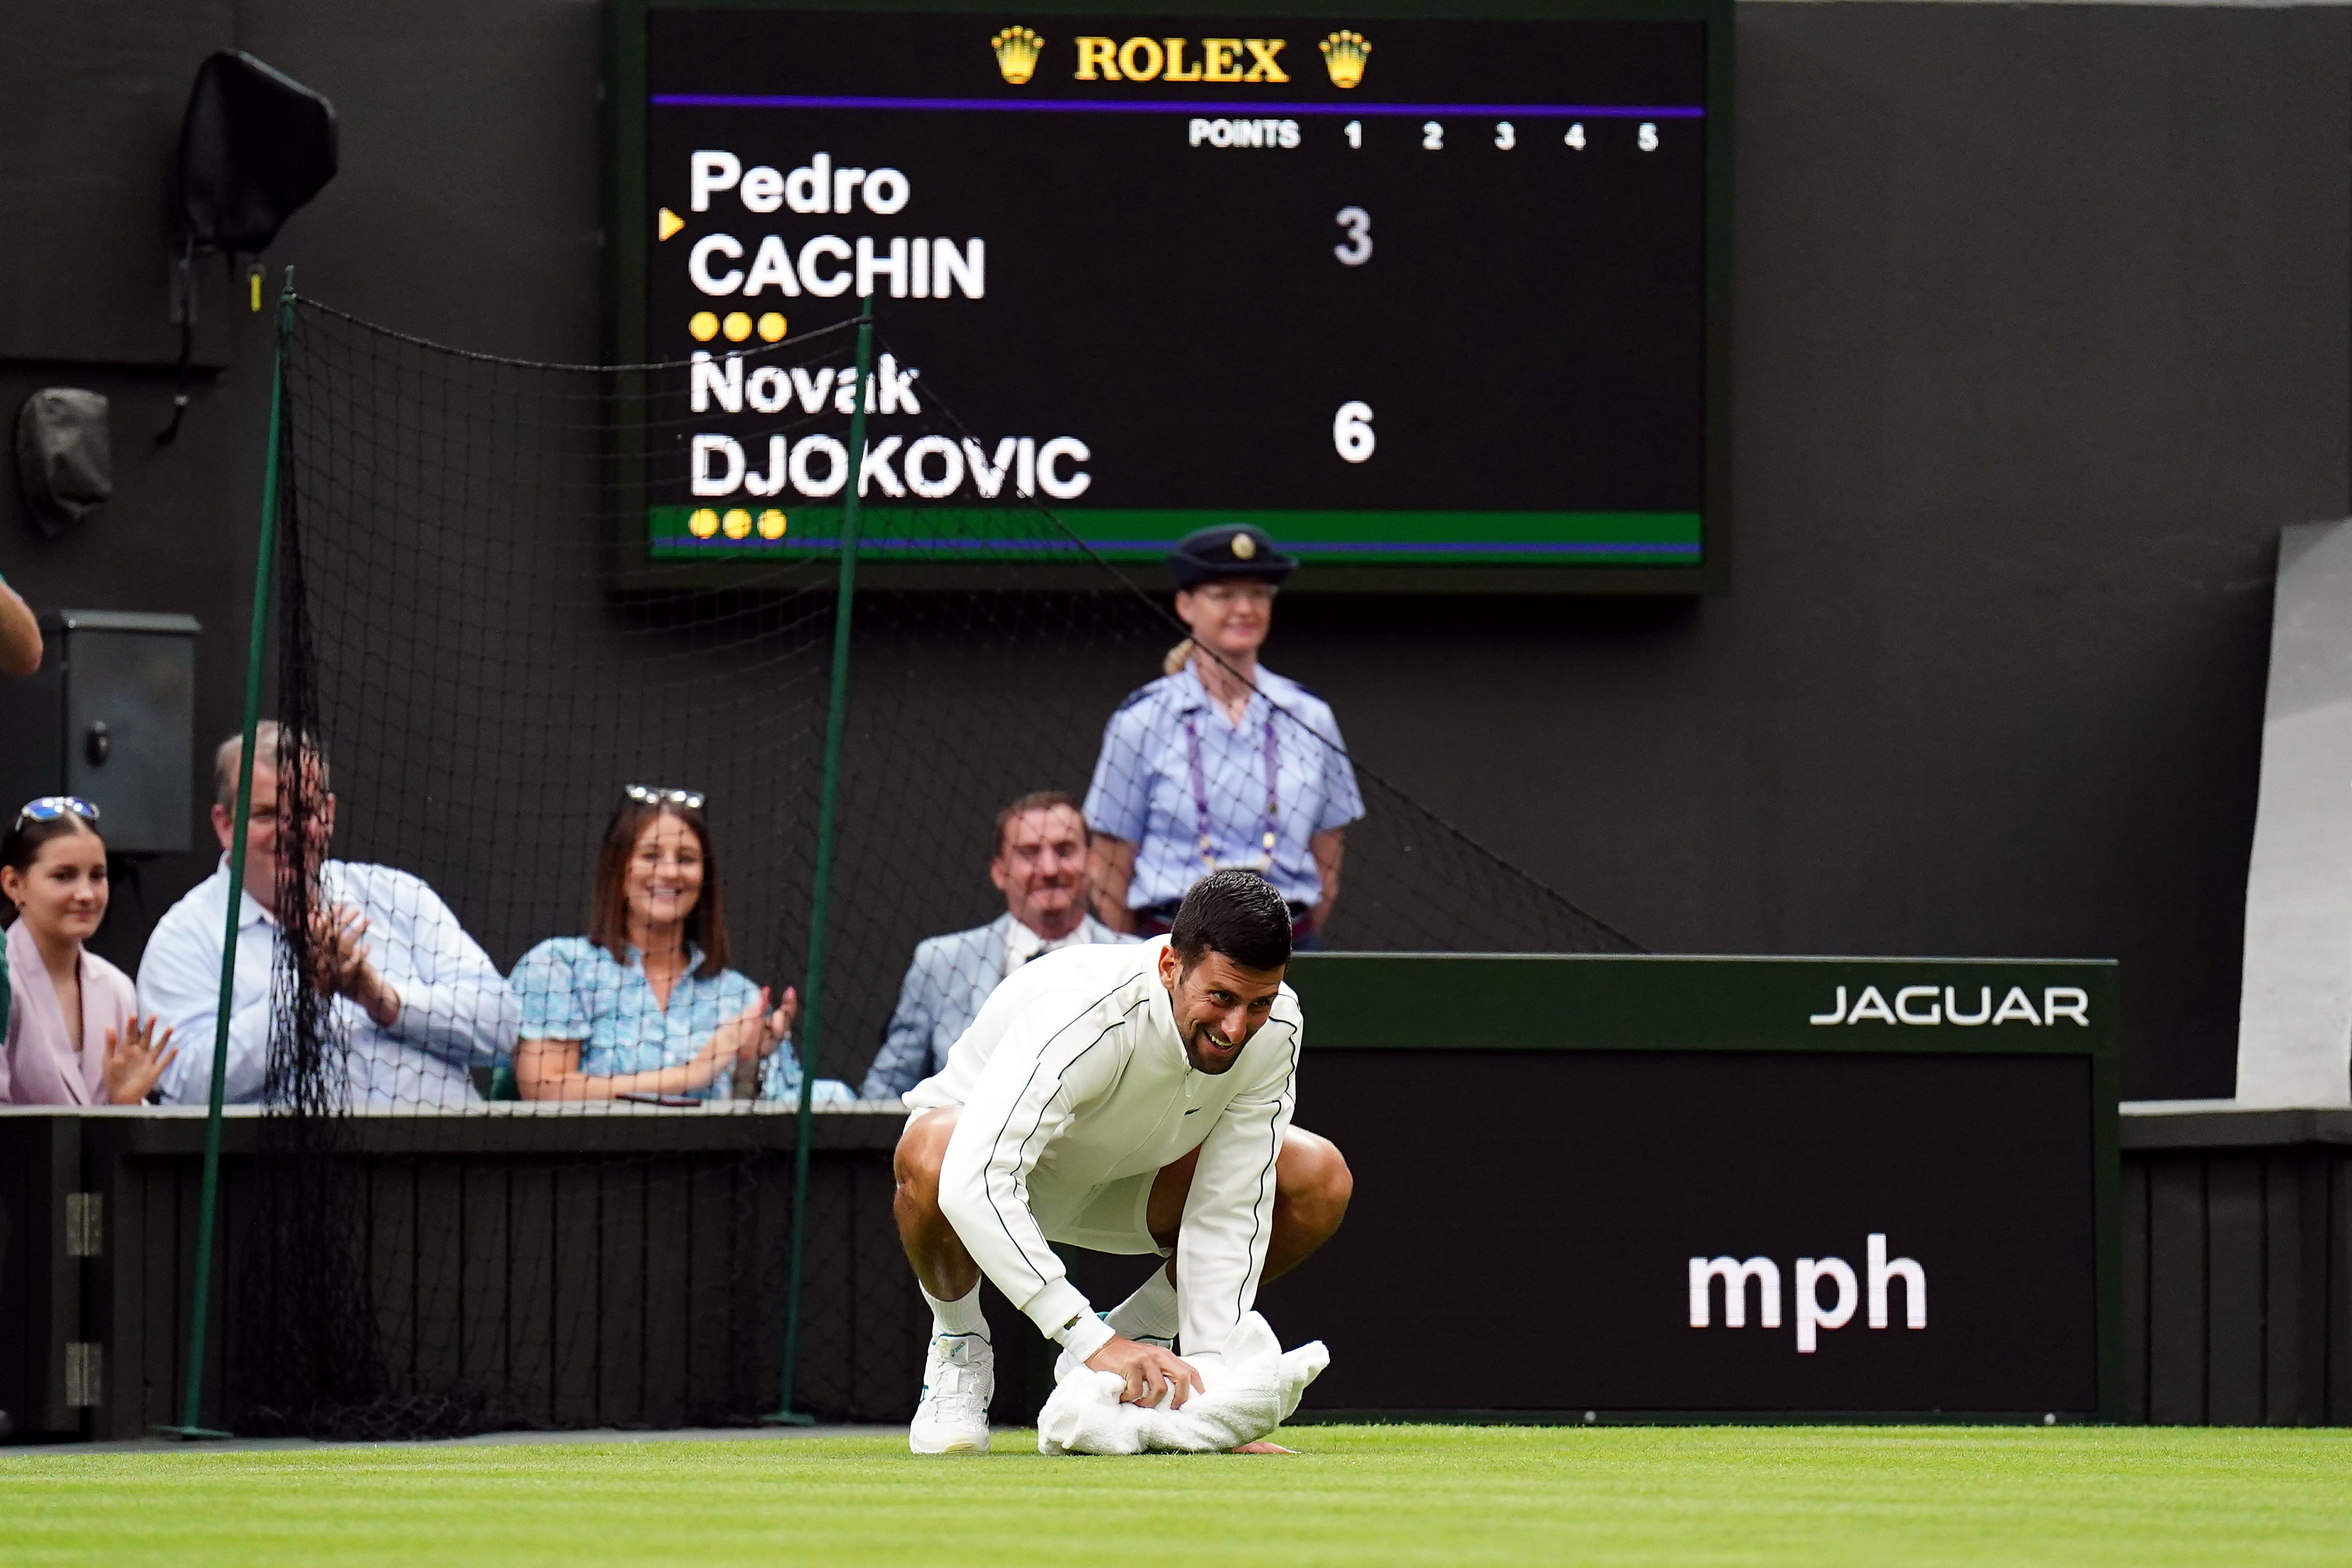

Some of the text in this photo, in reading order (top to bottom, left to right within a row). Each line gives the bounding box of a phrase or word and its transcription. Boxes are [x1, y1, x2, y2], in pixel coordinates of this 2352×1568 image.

[1074, 36, 1289, 82] ROLEX
[1188, 118, 1658, 152] POINTS 1 2 3 4 5
[691, 150, 910, 214] Pedro
[689, 234, 985, 299] CACHIN
[1335, 207, 1373, 265] 3
[691, 350, 921, 415] Novak
[1333, 401, 1375, 463] 6
[691, 433, 1091, 499] DJOKOVIC
[1810, 986, 2090, 1026] JAGUAR
[1689, 1233, 1927, 1354] mph
